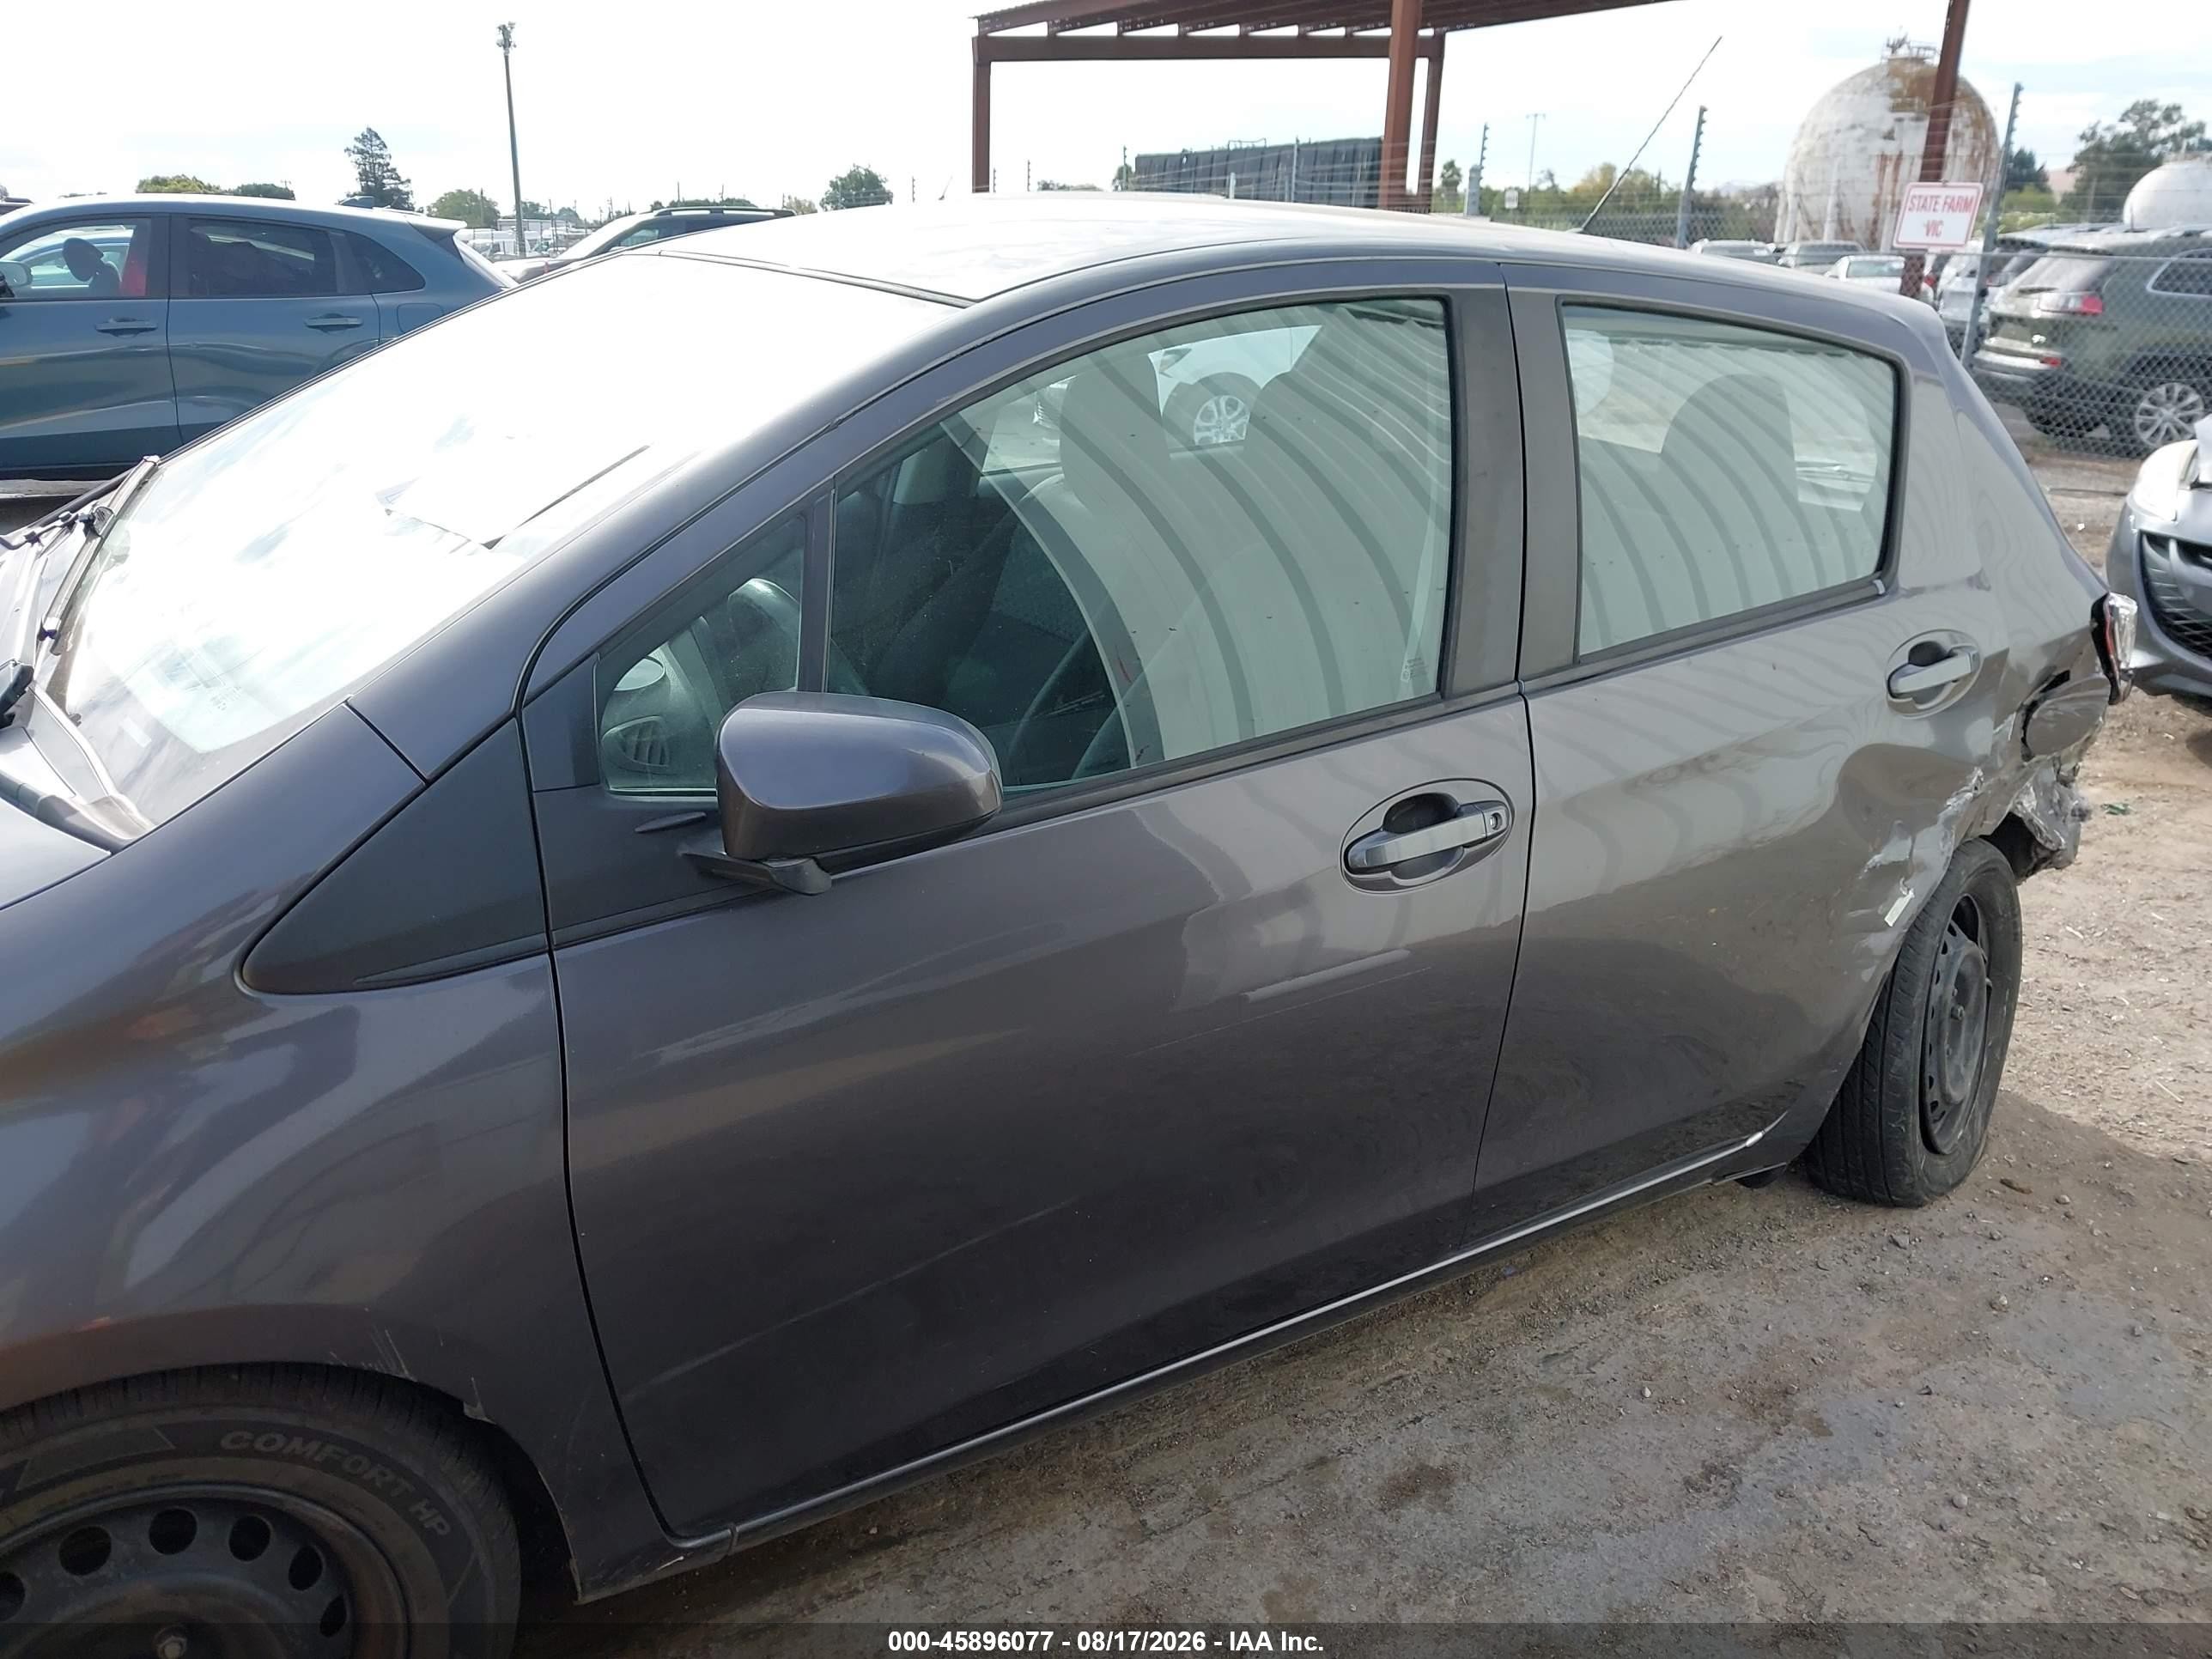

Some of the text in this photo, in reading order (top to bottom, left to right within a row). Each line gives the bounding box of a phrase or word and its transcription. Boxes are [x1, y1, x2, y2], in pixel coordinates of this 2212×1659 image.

[1908, 194, 1974, 214] STATE FARM
[1924, 219, 1944, 238] VIC
[220, 1431, 452, 1536] COMFORT HP
